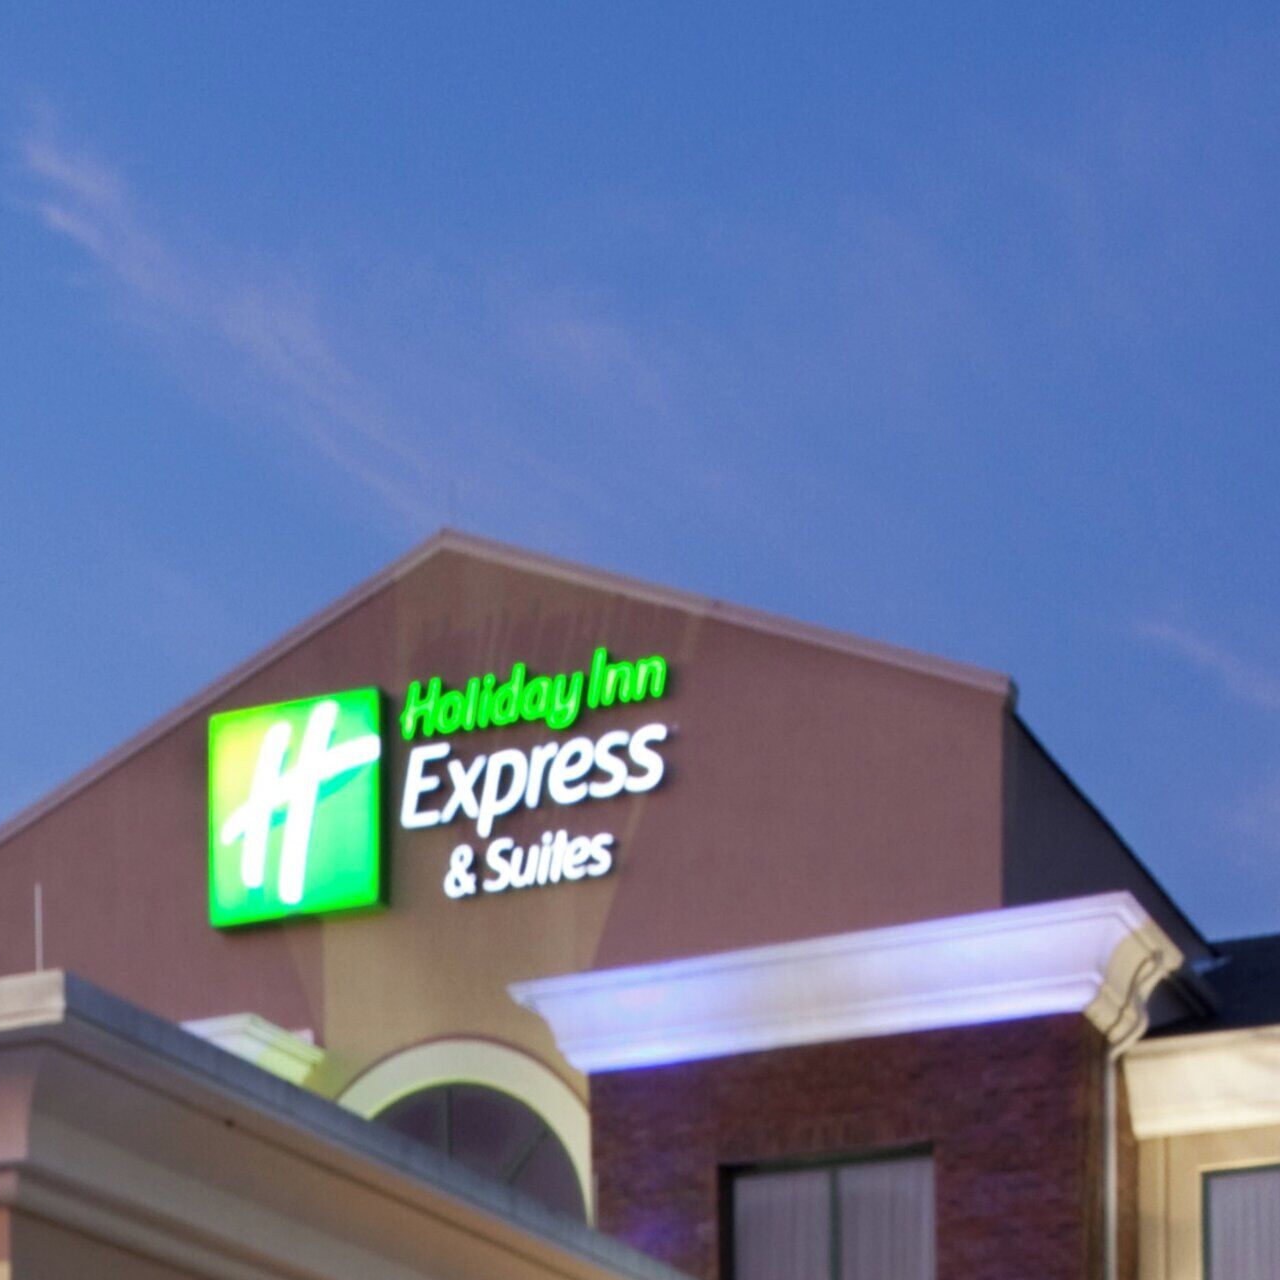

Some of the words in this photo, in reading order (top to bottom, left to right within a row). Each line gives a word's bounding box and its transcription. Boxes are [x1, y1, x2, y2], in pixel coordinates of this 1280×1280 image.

[401, 663, 583, 740] Holiday
[587, 647, 668, 708] Inn
[221, 699, 381, 905] H
[401, 723, 669, 837] Express
[443, 844, 477, 899] &
[482, 829, 614, 893] Suites
